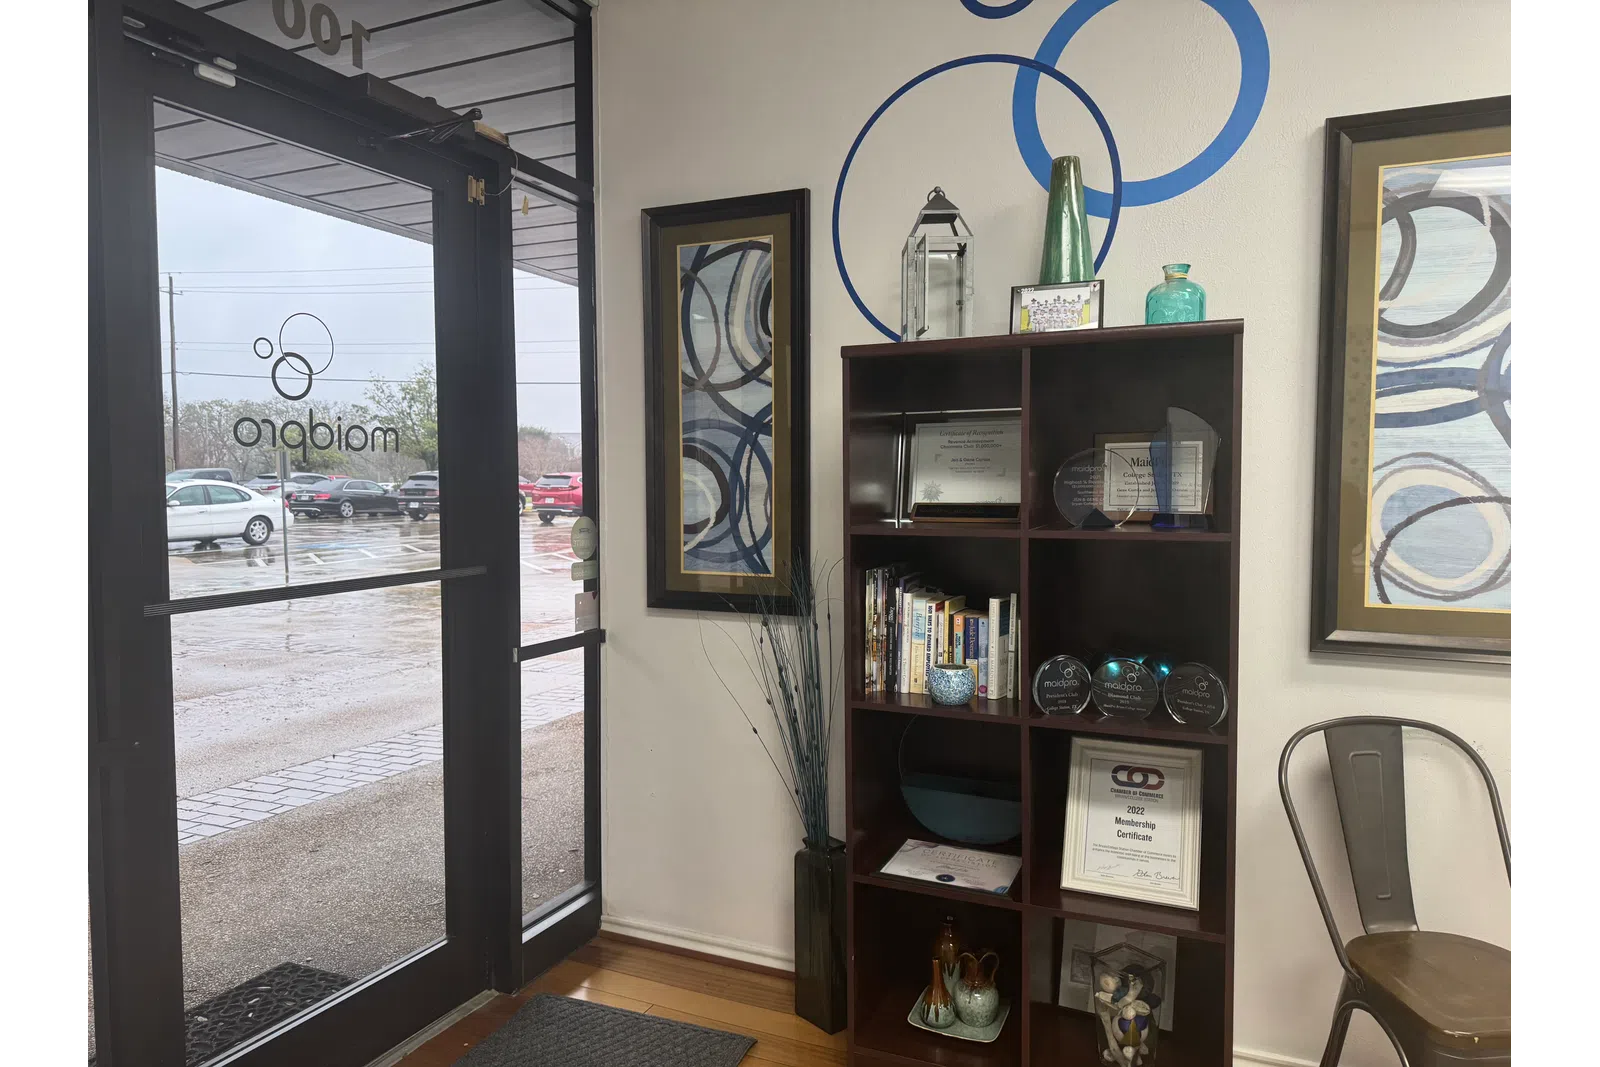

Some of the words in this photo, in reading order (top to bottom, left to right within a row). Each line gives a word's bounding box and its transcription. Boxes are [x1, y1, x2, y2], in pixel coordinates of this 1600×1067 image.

[972, 429, 1004, 437] Recognition
[1071, 464, 1102, 473] maidpro
[913, 612, 923, 638] Barefoot
[1182, 688, 1211, 699] maidpro
[1126, 805, 1145, 816] 2022
[1114, 816, 1156, 830] Membership
[1116, 829, 1153, 842] Certificate
[922, 848, 996, 865] CERTIFICATE
